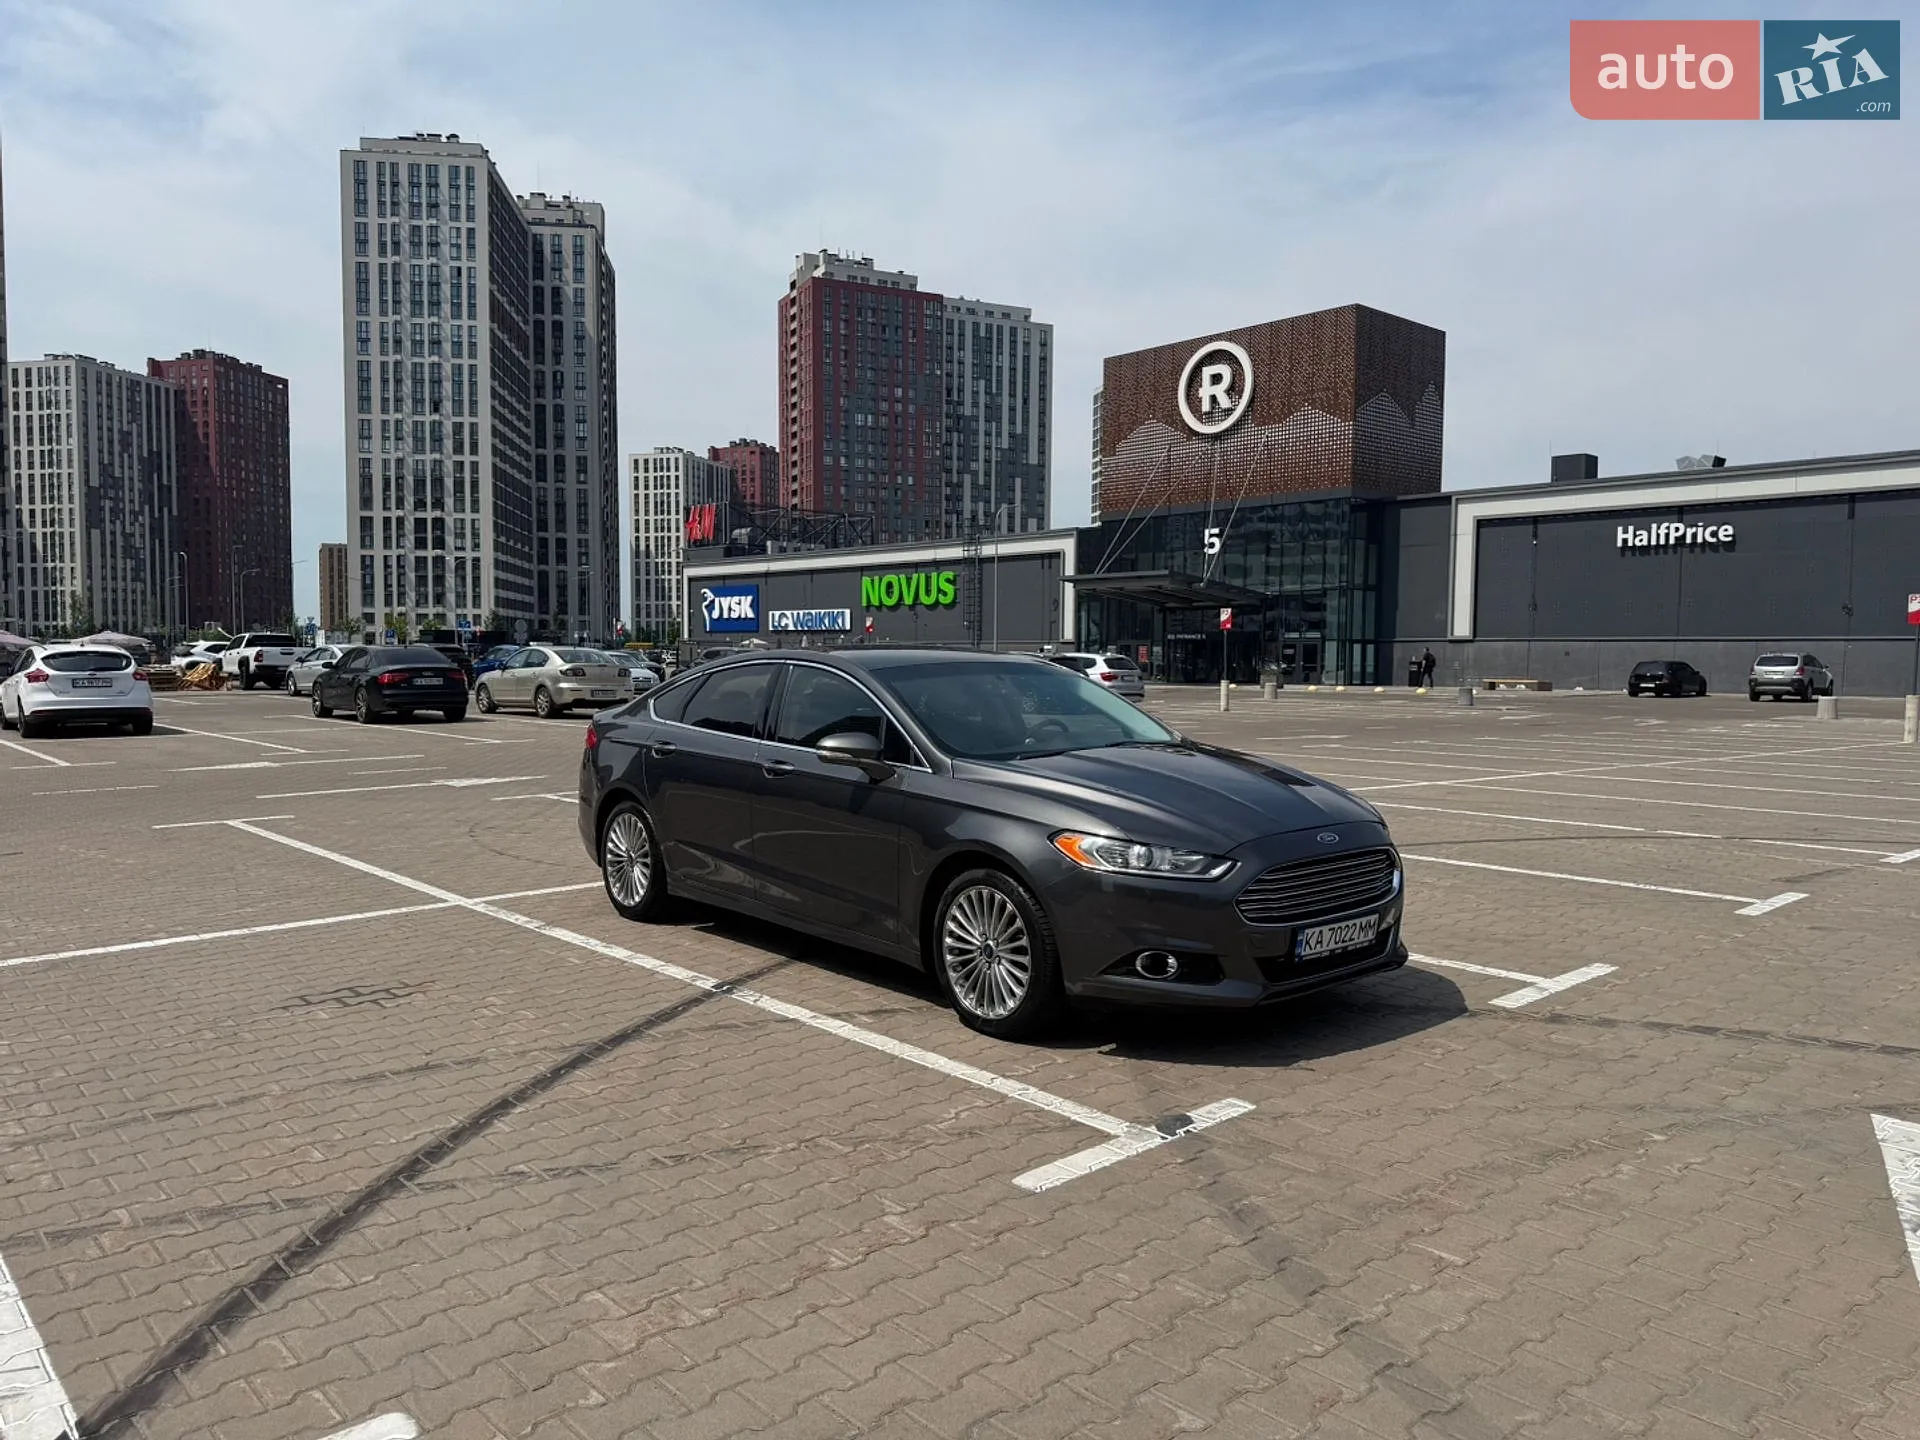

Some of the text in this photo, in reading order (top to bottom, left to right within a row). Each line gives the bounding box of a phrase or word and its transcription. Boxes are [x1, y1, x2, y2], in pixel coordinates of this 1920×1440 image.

[1203, 527, 1221, 555] 5
[1616, 522, 1735, 548] HalfPrice
[862, 571, 955, 606] NOVUS
[712, 595, 756, 619] JYSK
[771, 611, 790, 629] LC
[1304, 931, 1323, 952] KA
[1327, 924, 1357, 947] 7022
[1358, 919, 1376, 940] MM
